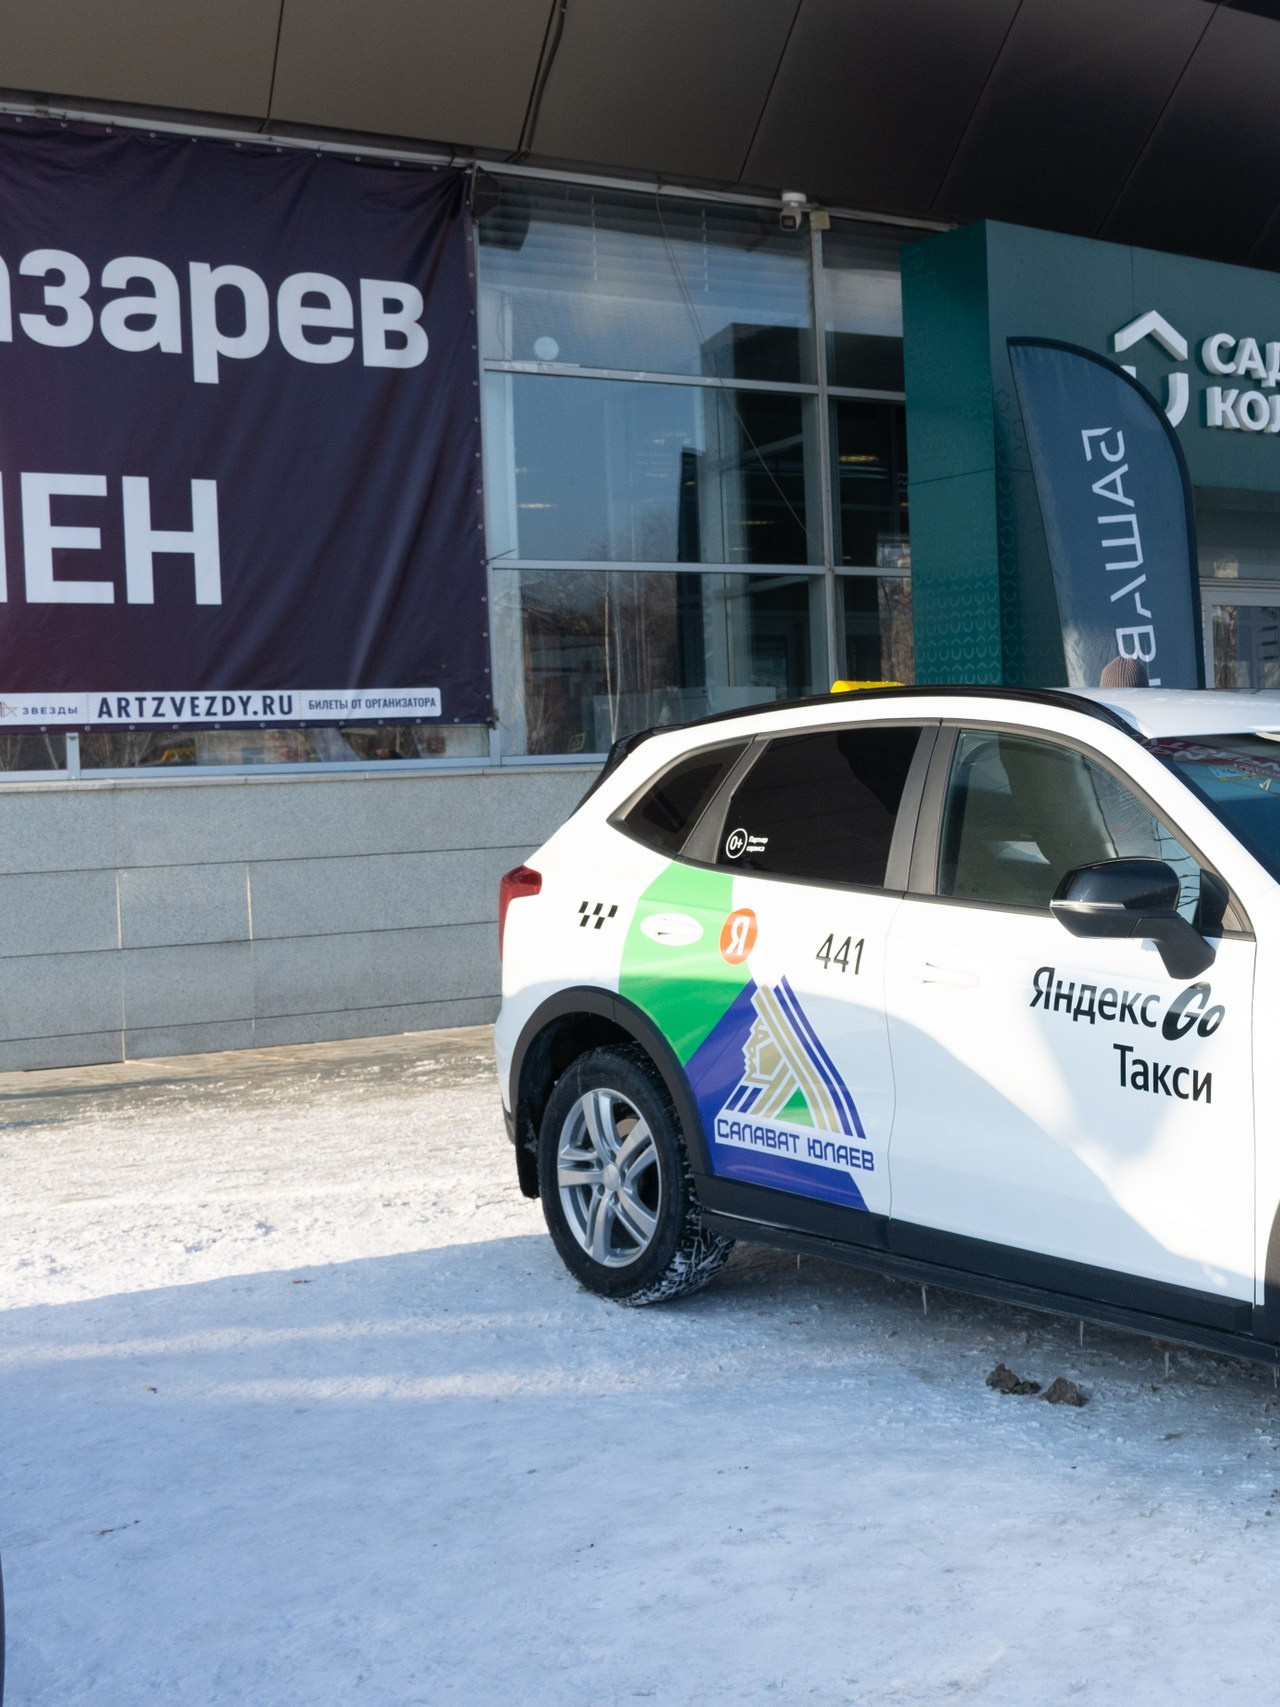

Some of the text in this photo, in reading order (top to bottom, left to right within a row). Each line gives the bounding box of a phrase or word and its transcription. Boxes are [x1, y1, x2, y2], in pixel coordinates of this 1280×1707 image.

[0, 470, 222, 605] ЕН
[22, 706, 78, 716] ЗВЕЗДЫ
[97, 695, 293, 719] ARTZVEZDY.RU
[308, 697, 437, 711] БИЛЕТЫ ОТ ОРГАНИЗАТОРА
[729, 916, 750, 957] Я
[815, 933, 866, 975] 441
[1029, 966, 1226, 1041] Яндекс Go
[1113, 1043, 1213, 1104] Такси
[716, 1118, 875, 1172] САЛАВАТ ЮЛАЕВ
